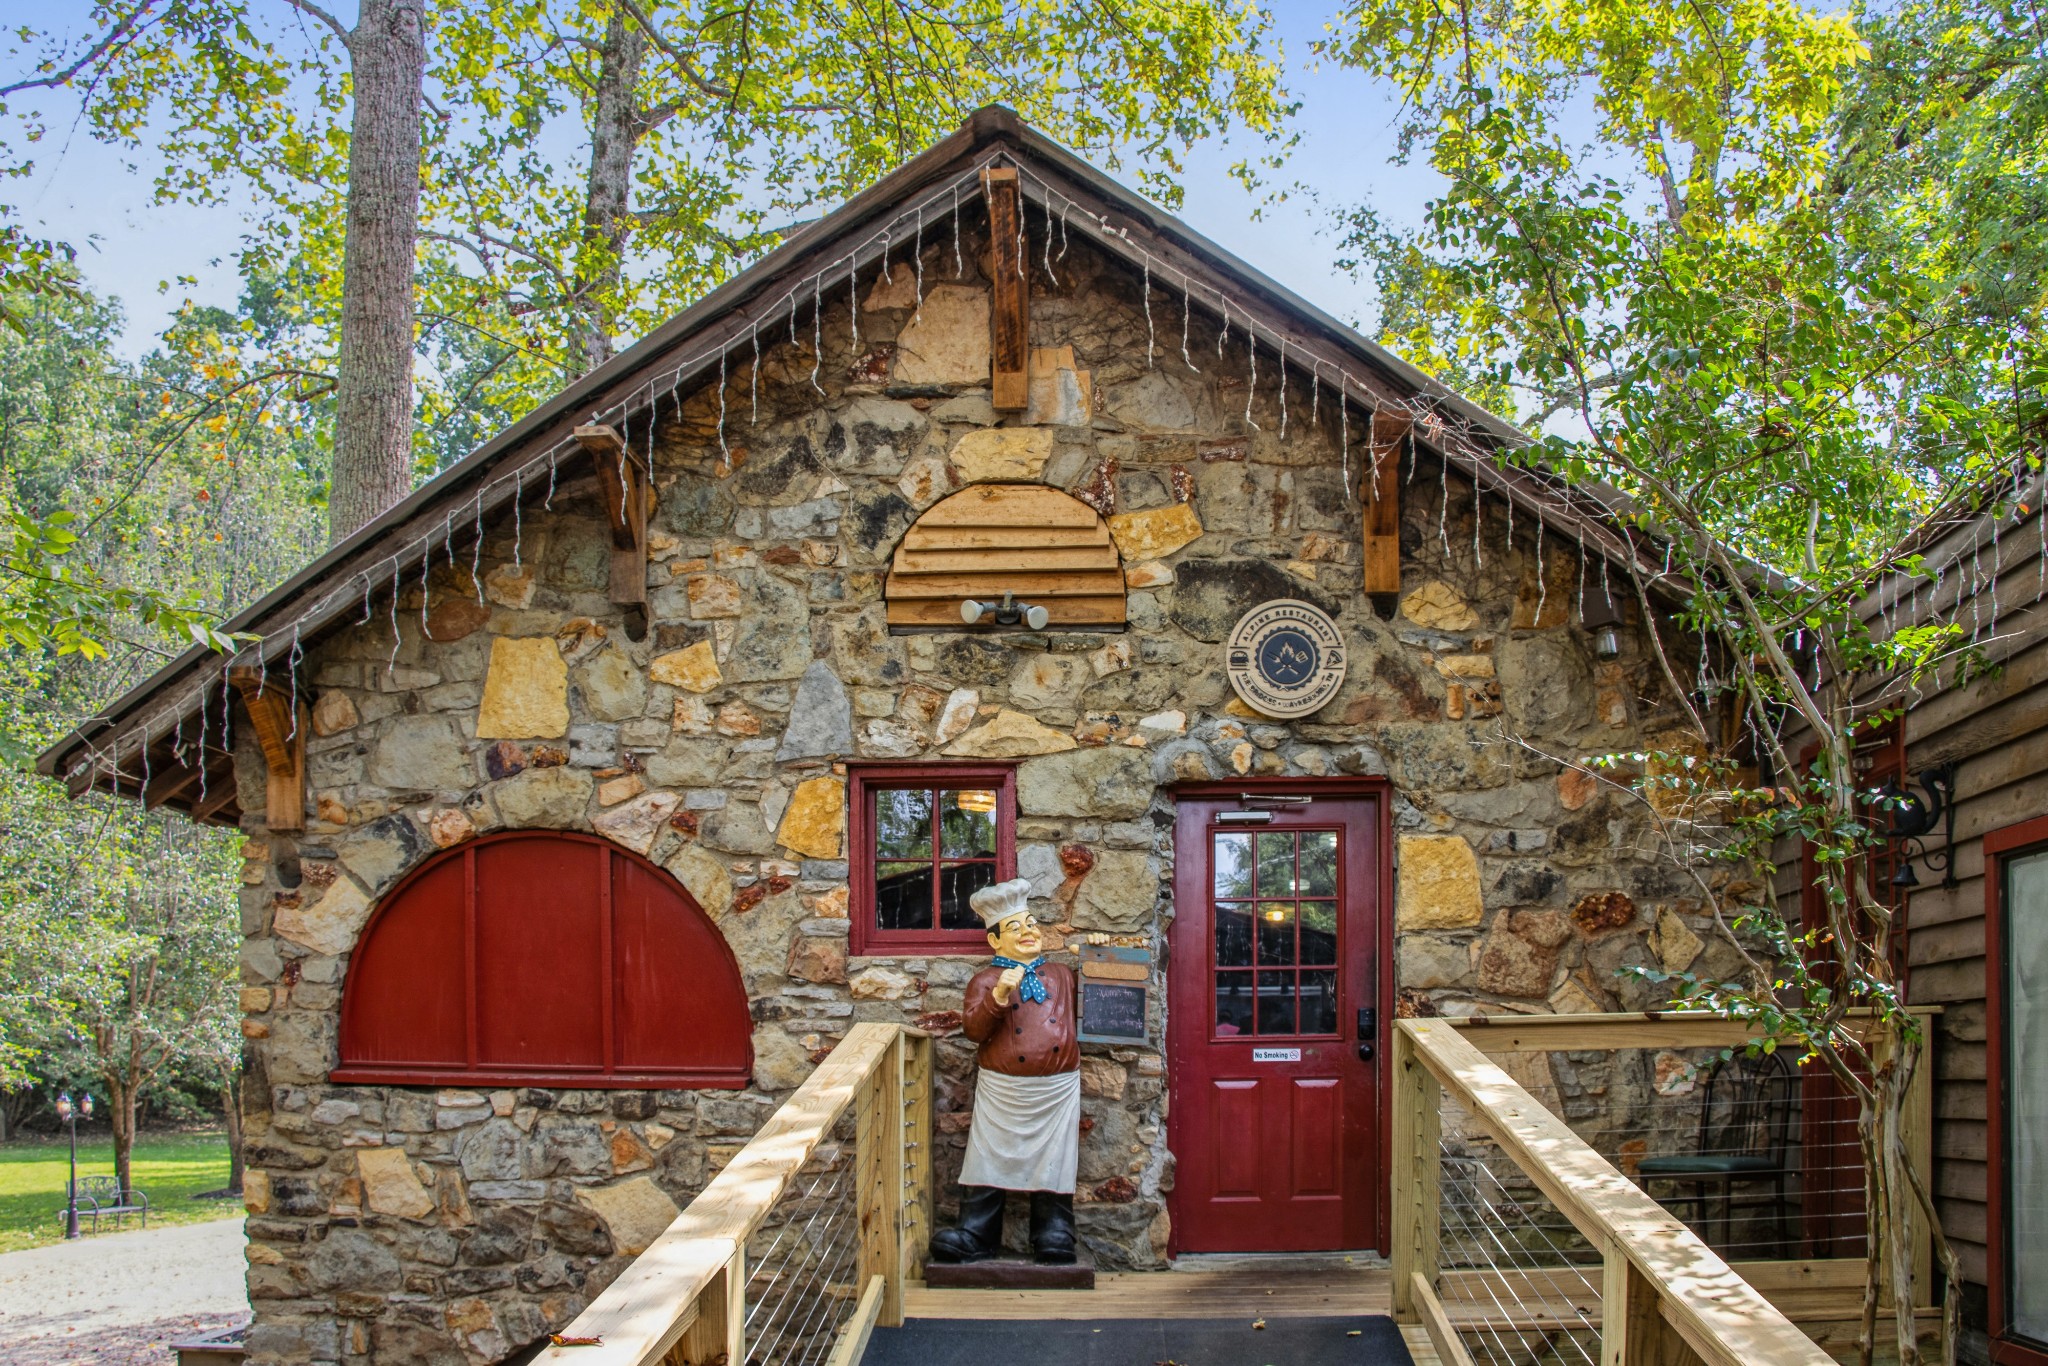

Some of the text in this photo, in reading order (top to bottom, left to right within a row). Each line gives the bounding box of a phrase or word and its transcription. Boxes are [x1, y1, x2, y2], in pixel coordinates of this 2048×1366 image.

[1243, 609, 1333, 641] ALPINE RESTAURANT
[1264, 1051, 1289, 1060] Smoking
